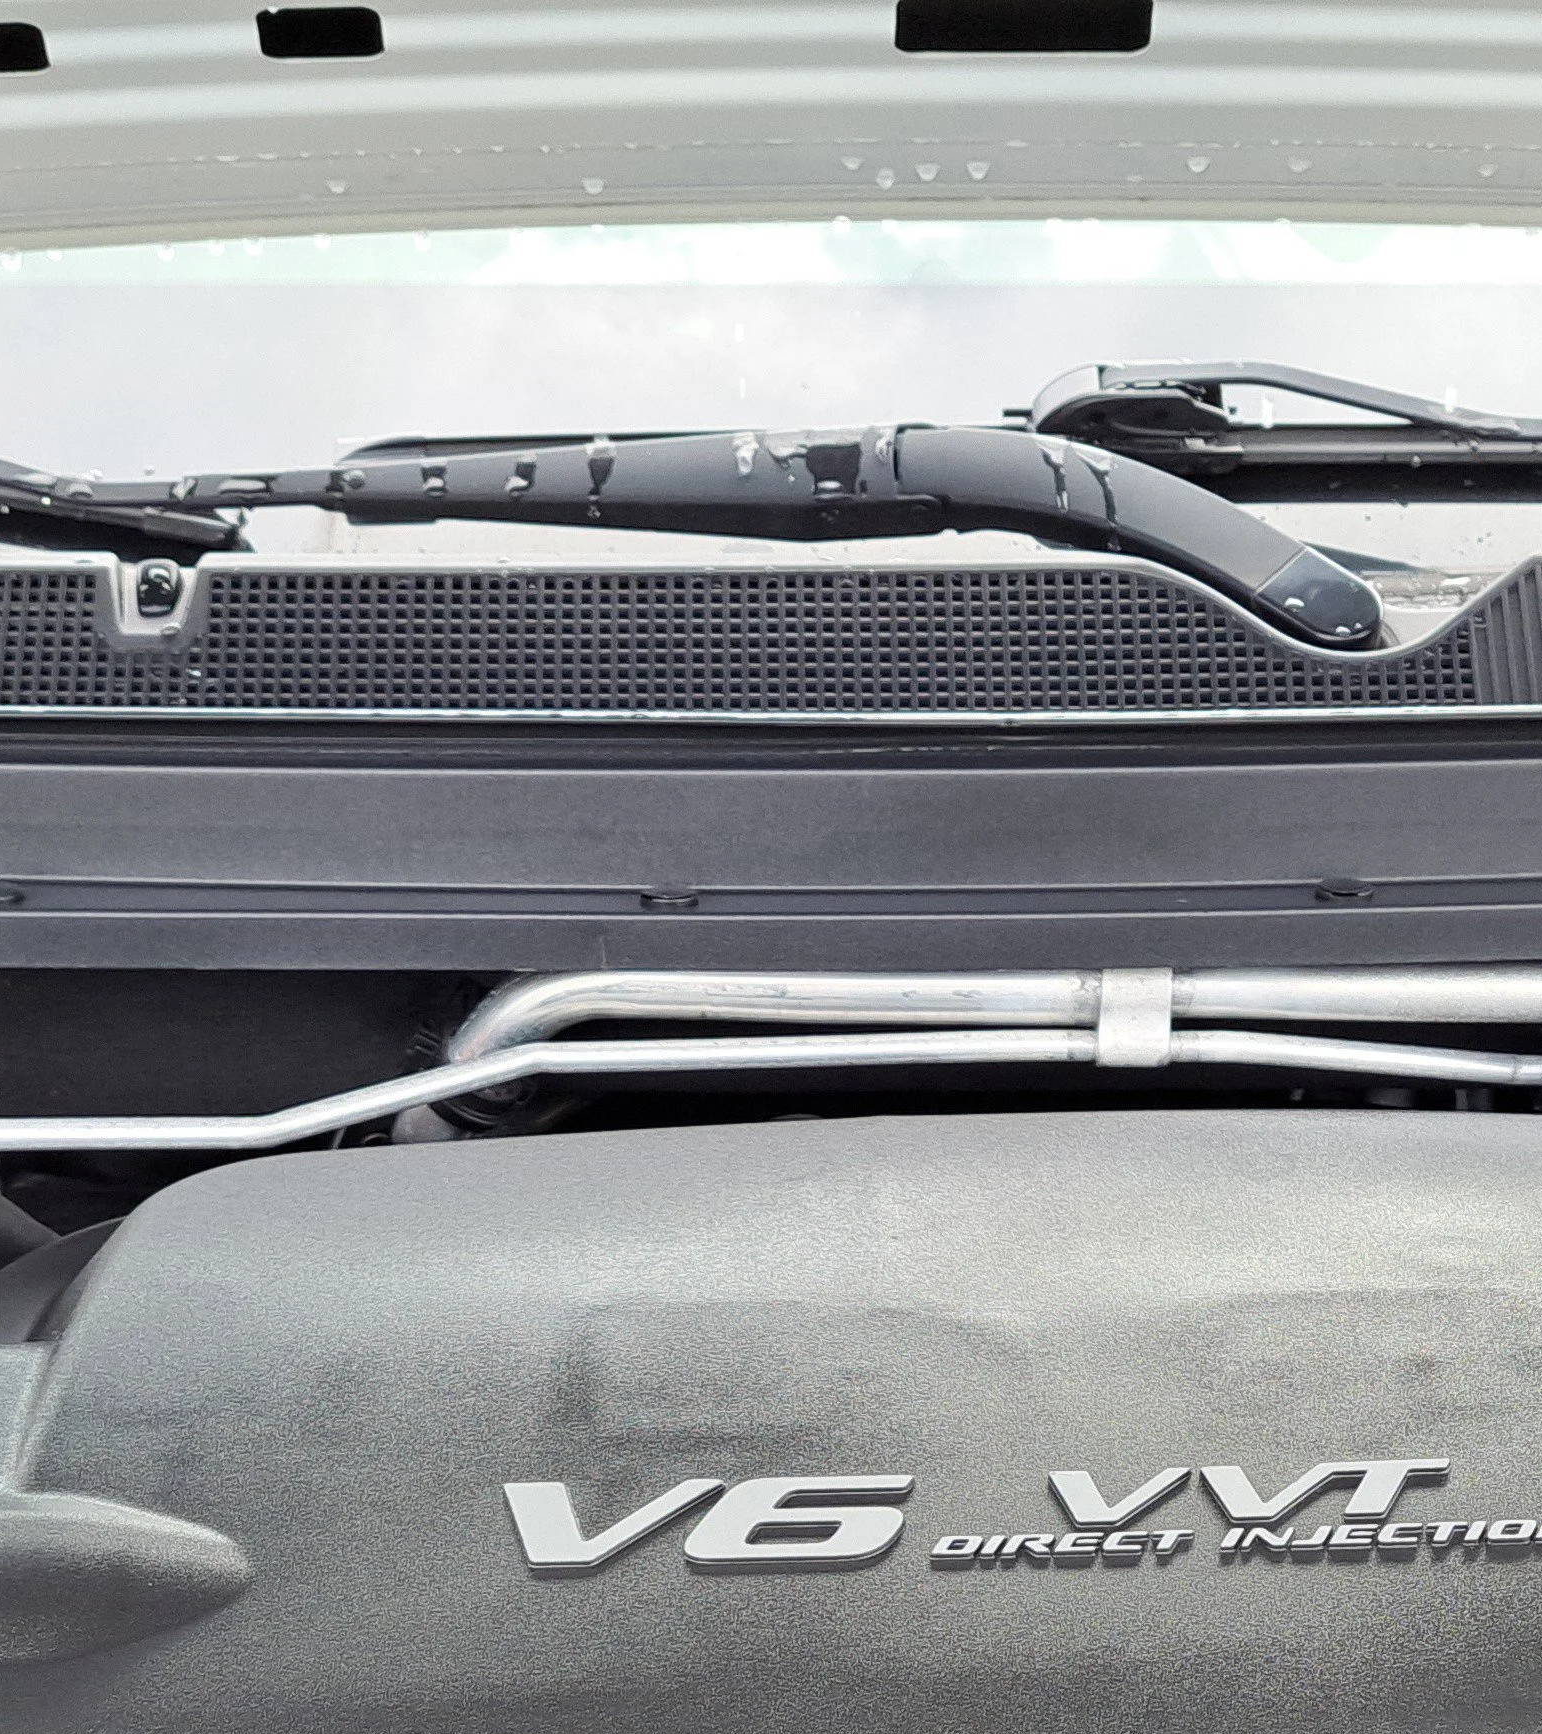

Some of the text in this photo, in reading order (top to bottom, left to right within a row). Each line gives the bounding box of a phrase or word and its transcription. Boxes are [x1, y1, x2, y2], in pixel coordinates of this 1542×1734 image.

[503, 1457, 1451, 1568] V6 VVT
[929, 1528, 1196, 1560] DIRECT
